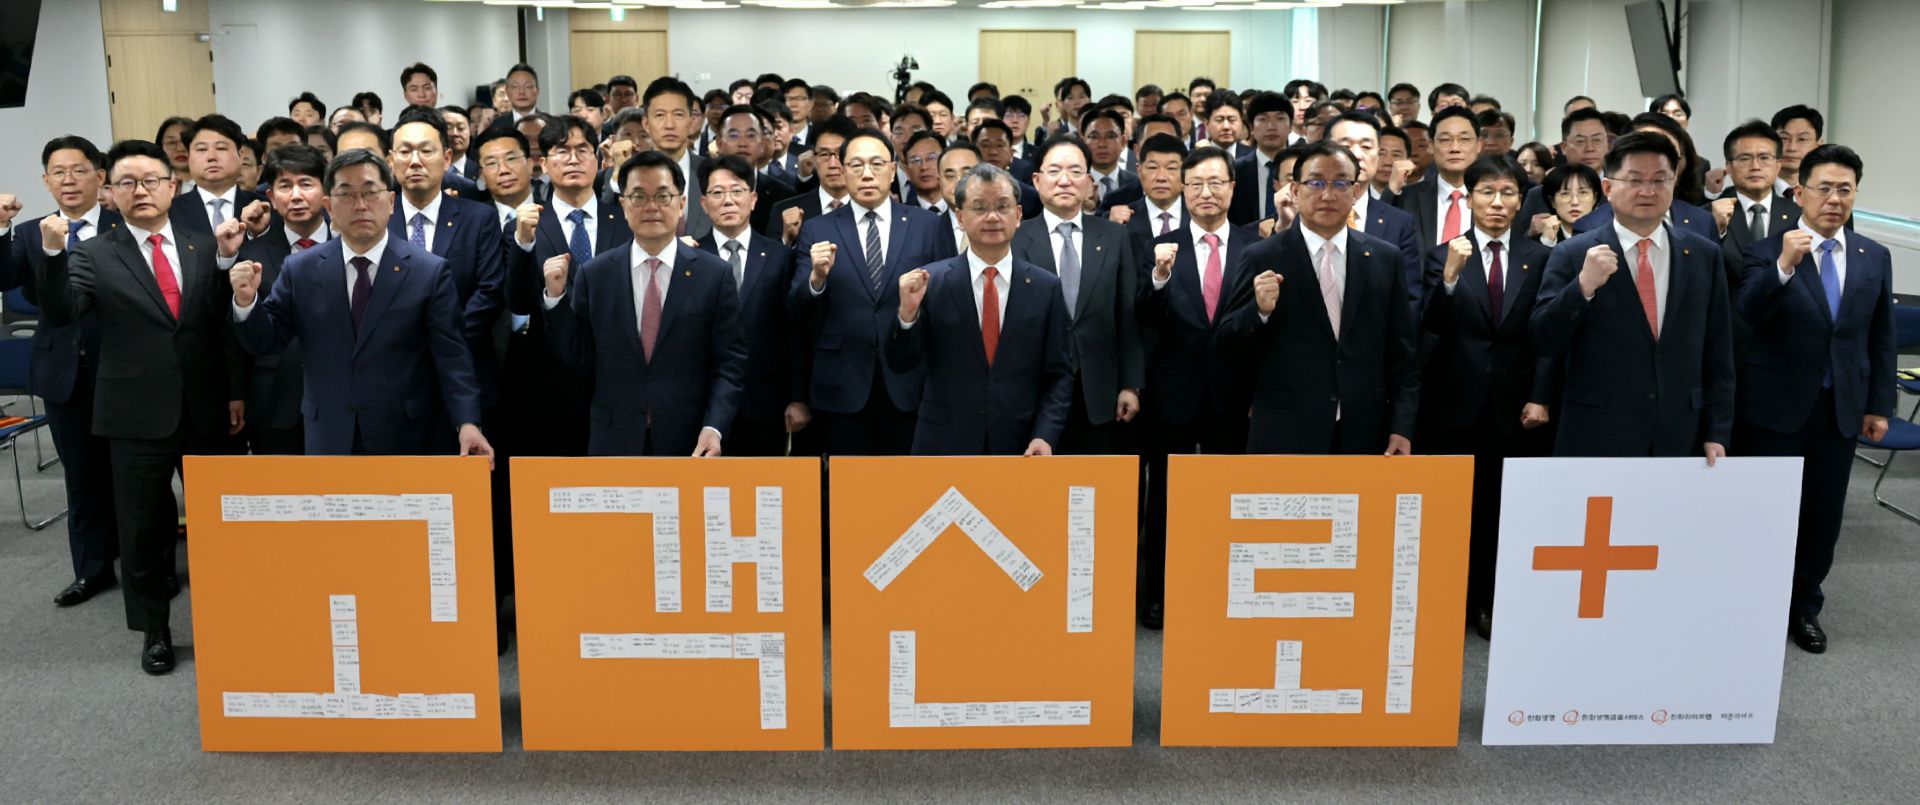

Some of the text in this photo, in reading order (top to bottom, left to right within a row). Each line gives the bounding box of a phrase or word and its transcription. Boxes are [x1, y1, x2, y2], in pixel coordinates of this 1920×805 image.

[221, 493, 477, 719] 고
[548, 486, 787, 730] 객
[863, 485, 1096, 727] 신
[1208, 493, 1423, 714] 뢰
